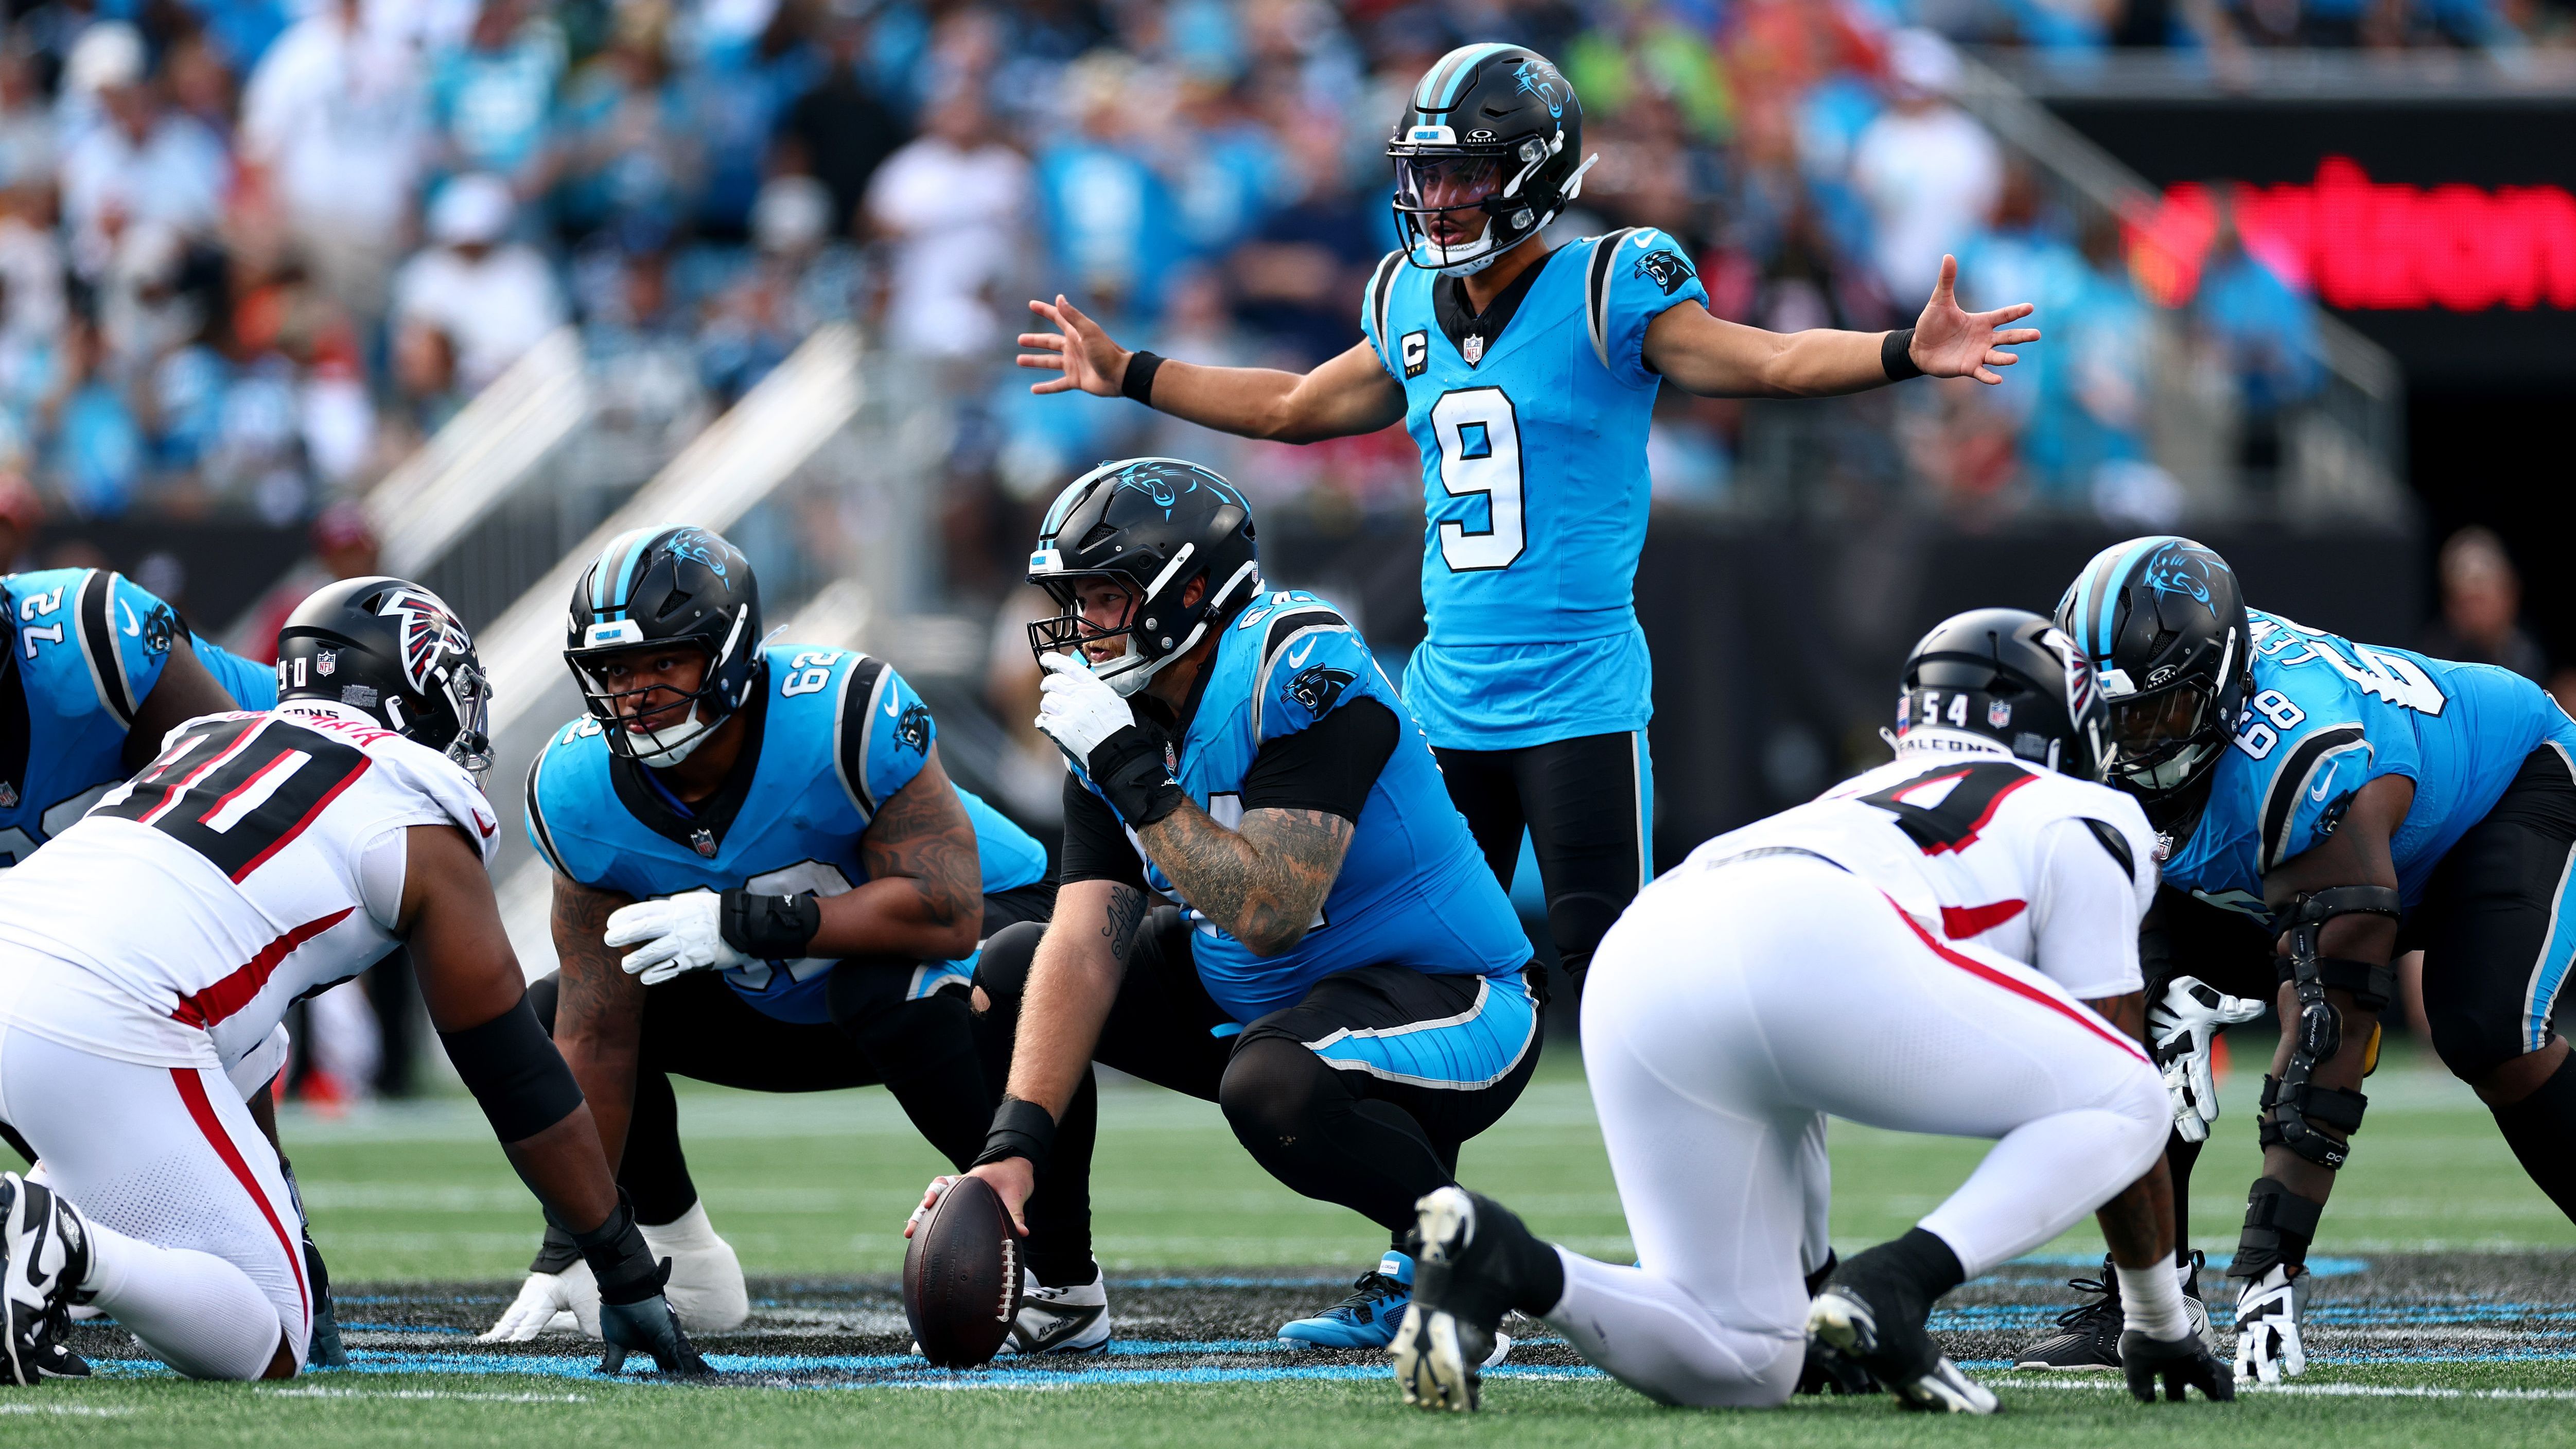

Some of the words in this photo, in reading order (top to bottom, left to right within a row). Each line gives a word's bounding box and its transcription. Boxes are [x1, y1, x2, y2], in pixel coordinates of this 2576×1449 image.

[1402, 335, 1425, 368] C
[1467, 348, 1479, 359] NFL
[1429, 385, 1527, 573] 9
[21, 583, 65, 659] 72
[279, 657, 307, 691] 90
[319, 662, 333, 672] NFL
[780, 652, 847, 698] 62
[2147, 670, 2176, 689] OAKLEY
[1922, 691, 1968, 727] 54
[2234, 689, 2307, 761] 68
[560, 711, 603, 745] 2
[85, 716, 372, 885] 90
[2309, 1011, 2319, 1048] DONJOY
[951, 1216, 962, 1254] NATIONAL
[945, 1258, 957, 1302] FOOTBALL
[1038, 1315, 1074, 1340] ALPHA
